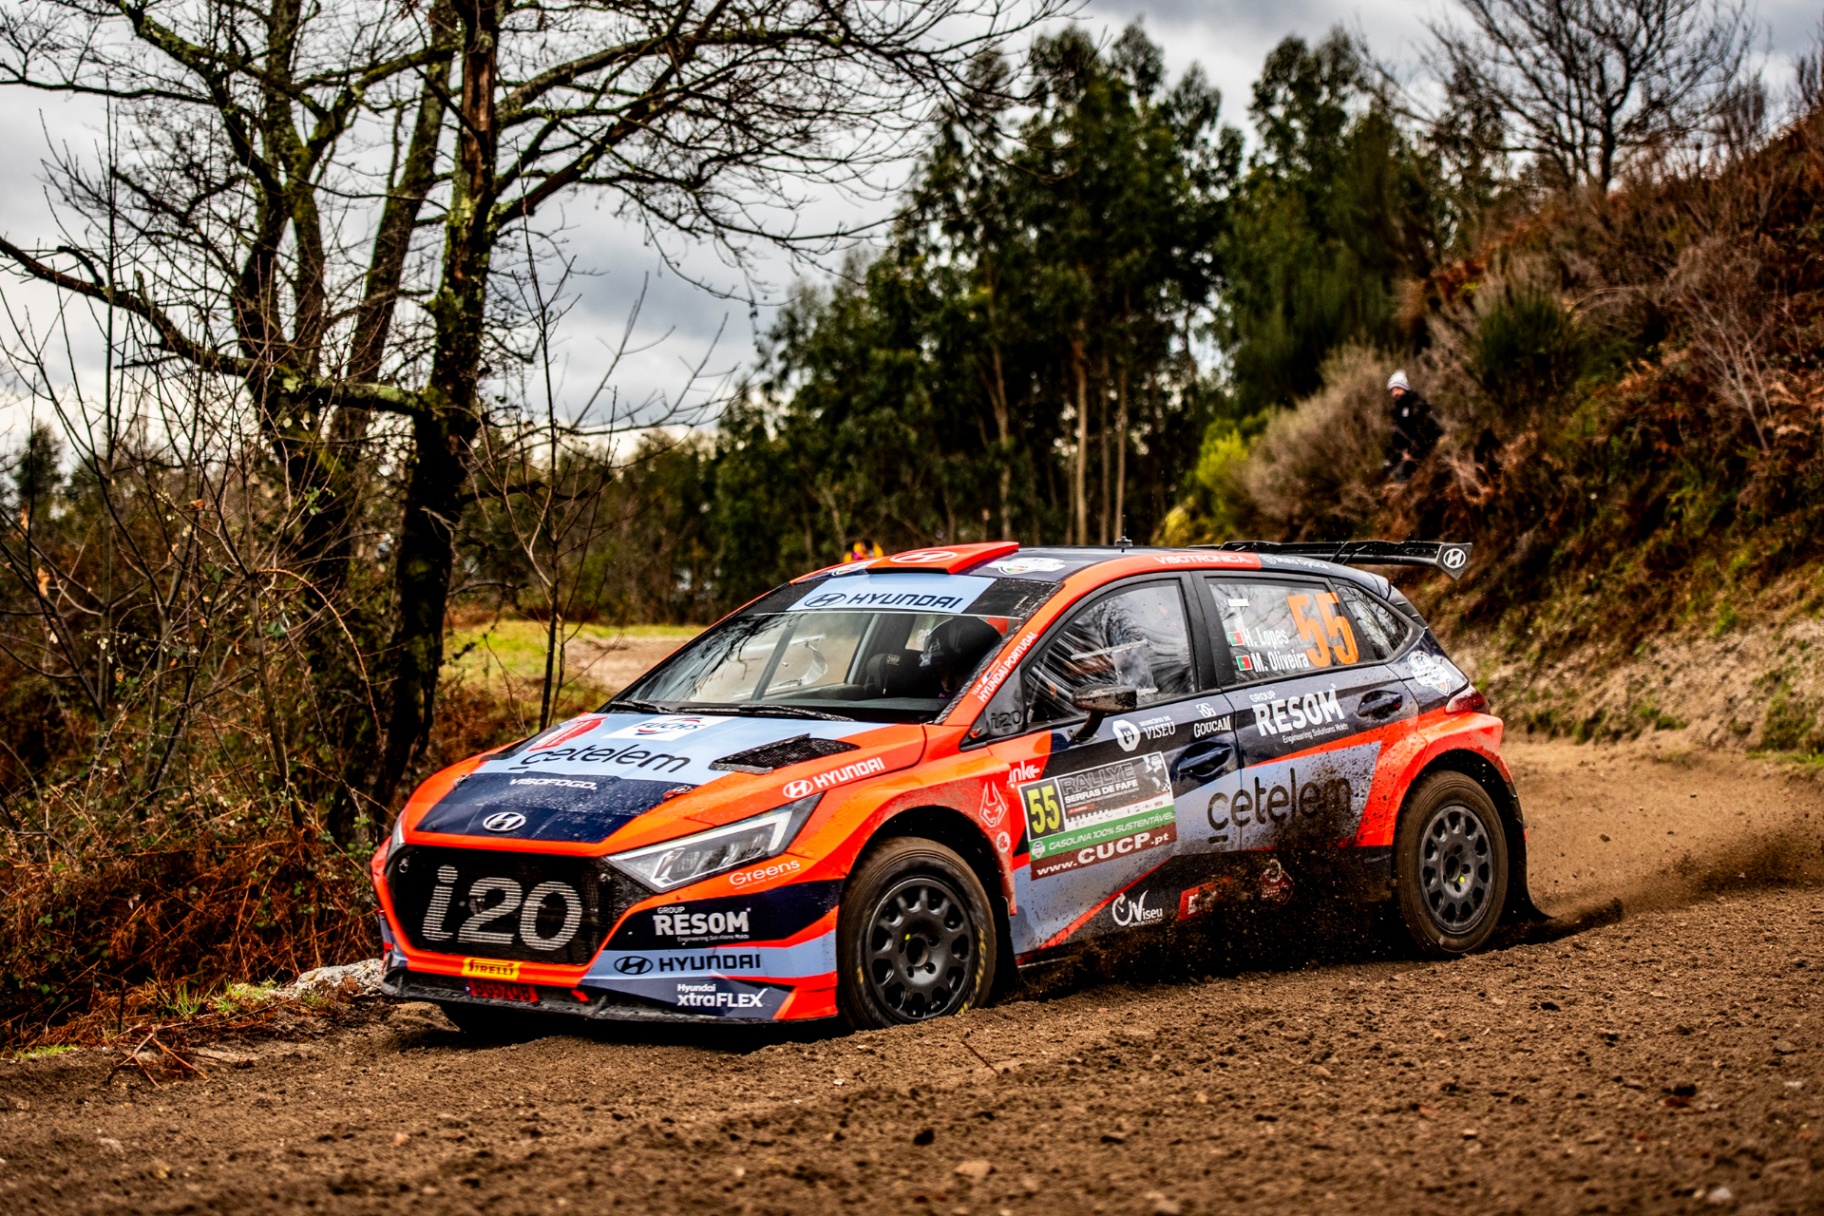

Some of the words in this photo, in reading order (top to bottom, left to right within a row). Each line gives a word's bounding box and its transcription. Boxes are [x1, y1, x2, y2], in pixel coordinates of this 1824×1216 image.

[849, 593, 962, 608] HYUNDAI
[1243, 628, 1258, 648] H.
[1254, 627, 1289, 650] Lopes
[1286, 592, 1359, 668] 55
[977, 667, 1009, 703] HYUNDAI
[1004, 631, 1038, 669] PORTUGAL
[1250, 652, 1269, 673] M.
[1268, 649, 1310, 672] Oliveira
[1249, 691, 1275, 703] GROUP
[991, 710, 1022, 729] i20
[1252, 689, 1345, 737] RESOM
[1143, 721, 1175, 740] VISEU
[1194, 716, 1231, 738] GOUCAM
[509, 744, 691, 773] cetelem
[813, 757, 885, 788] HYUNDAI
[1059, 762, 1137, 796] RALLYE
[1064, 788, 1101, 804] SERRAS
[1101, 785, 1115, 794] DE
[1115, 779, 1139, 792] FAFE
[1026, 785, 1060, 834] 55
[1207, 767, 1351, 843] cetelem
[1049, 832, 1091, 851] GASOLINA
[1092, 826, 1114, 839] 100%
[1115, 811, 1175, 833] SUSTENTÁVEL
[1037, 832, 1169, 876] www.CUCP.pt
[729, 860, 800, 885] Greens
[421, 864, 583, 951] i20
[657, 906, 686, 914] GROUP
[652, 911, 750, 935] RESOM
[469, 959, 514, 976] PIRELLI
[659, 954, 761, 972] HYUNDAI
[677, 984, 716, 993] Hyundai
[677, 988, 768, 1008] xtraFLEX
